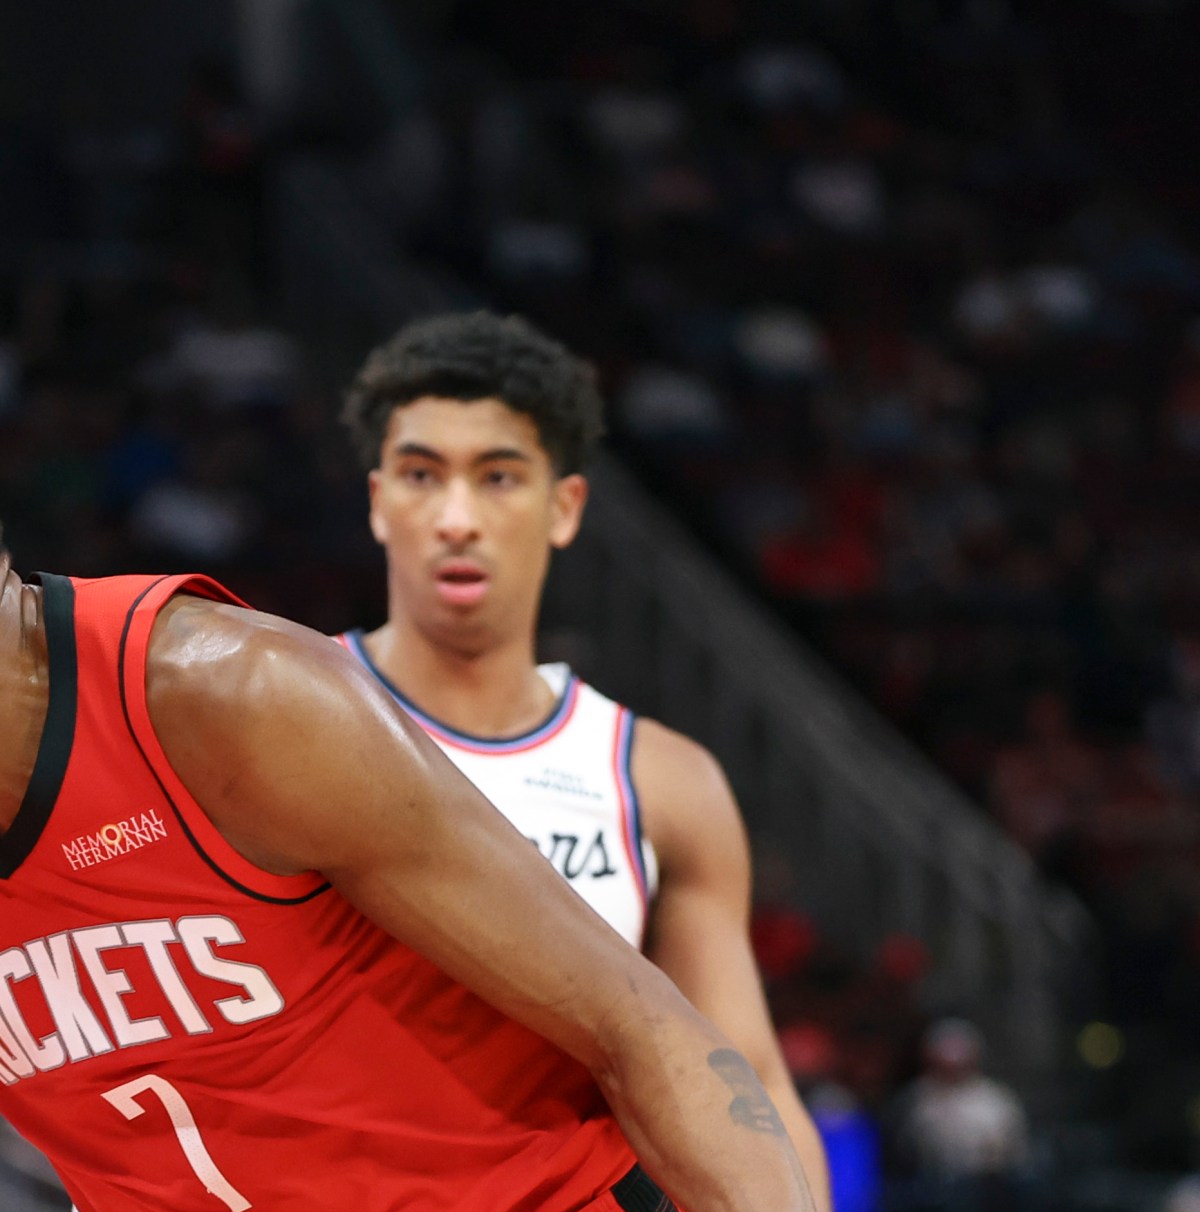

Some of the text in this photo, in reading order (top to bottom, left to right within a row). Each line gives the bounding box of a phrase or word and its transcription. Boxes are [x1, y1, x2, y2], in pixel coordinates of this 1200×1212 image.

[61, 809, 163, 857] MEMORIAL
[66, 822, 167, 871] HERMANN
[530, 831, 617, 879] rs
